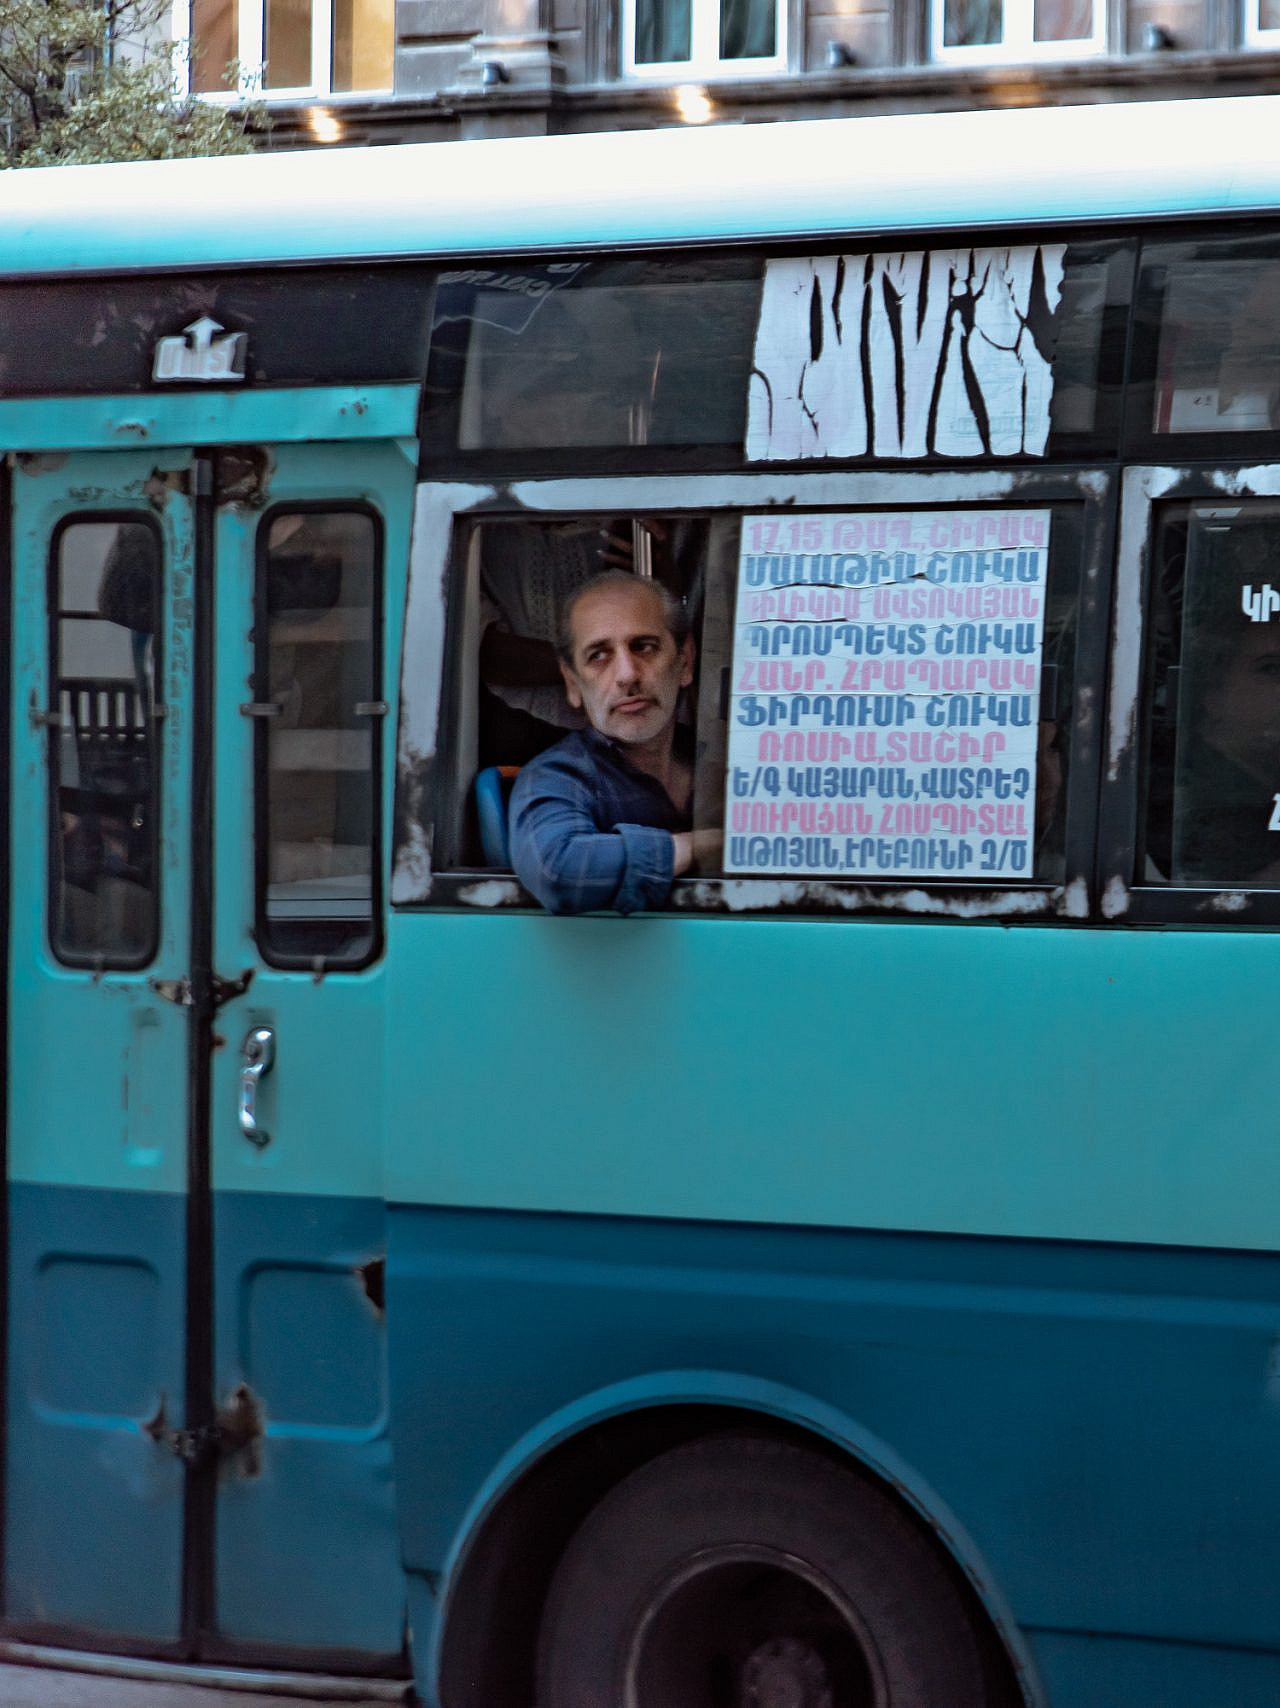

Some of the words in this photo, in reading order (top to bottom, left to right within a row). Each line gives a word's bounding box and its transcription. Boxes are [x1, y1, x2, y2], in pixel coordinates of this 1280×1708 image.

[748, 521, 823, 552] 17,15
[745, 553, 916, 586] ՄԱԼԱԹԻԱ
[927, 552, 1039, 583] ՇՈՒԿԱ
[872, 587, 1039, 619] ԱՎՏՈԿԱՅԱՆ
[744, 625, 927, 656] ՊՐՈՍՊԵԿՏ
[935, 623, 1036, 654] ՇՈՒԿԱ
[739, 661, 834, 691] ՀԱՆՐ.
[842, 659, 1036, 691] ՀՐԱՊԱՐԱԿ
[736, 696, 915, 727] ՖԻՐԴՈՒՍԻ
[926, 695, 1031, 726] ՇՈՒԿԱ
[733, 767, 781, 797] Ե/Գ
[732, 801, 872, 834] ՄՈՒՐԱՑԱՆ
[879, 803, 1028, 836] ՀՈՍՊԻՏԱԼ
